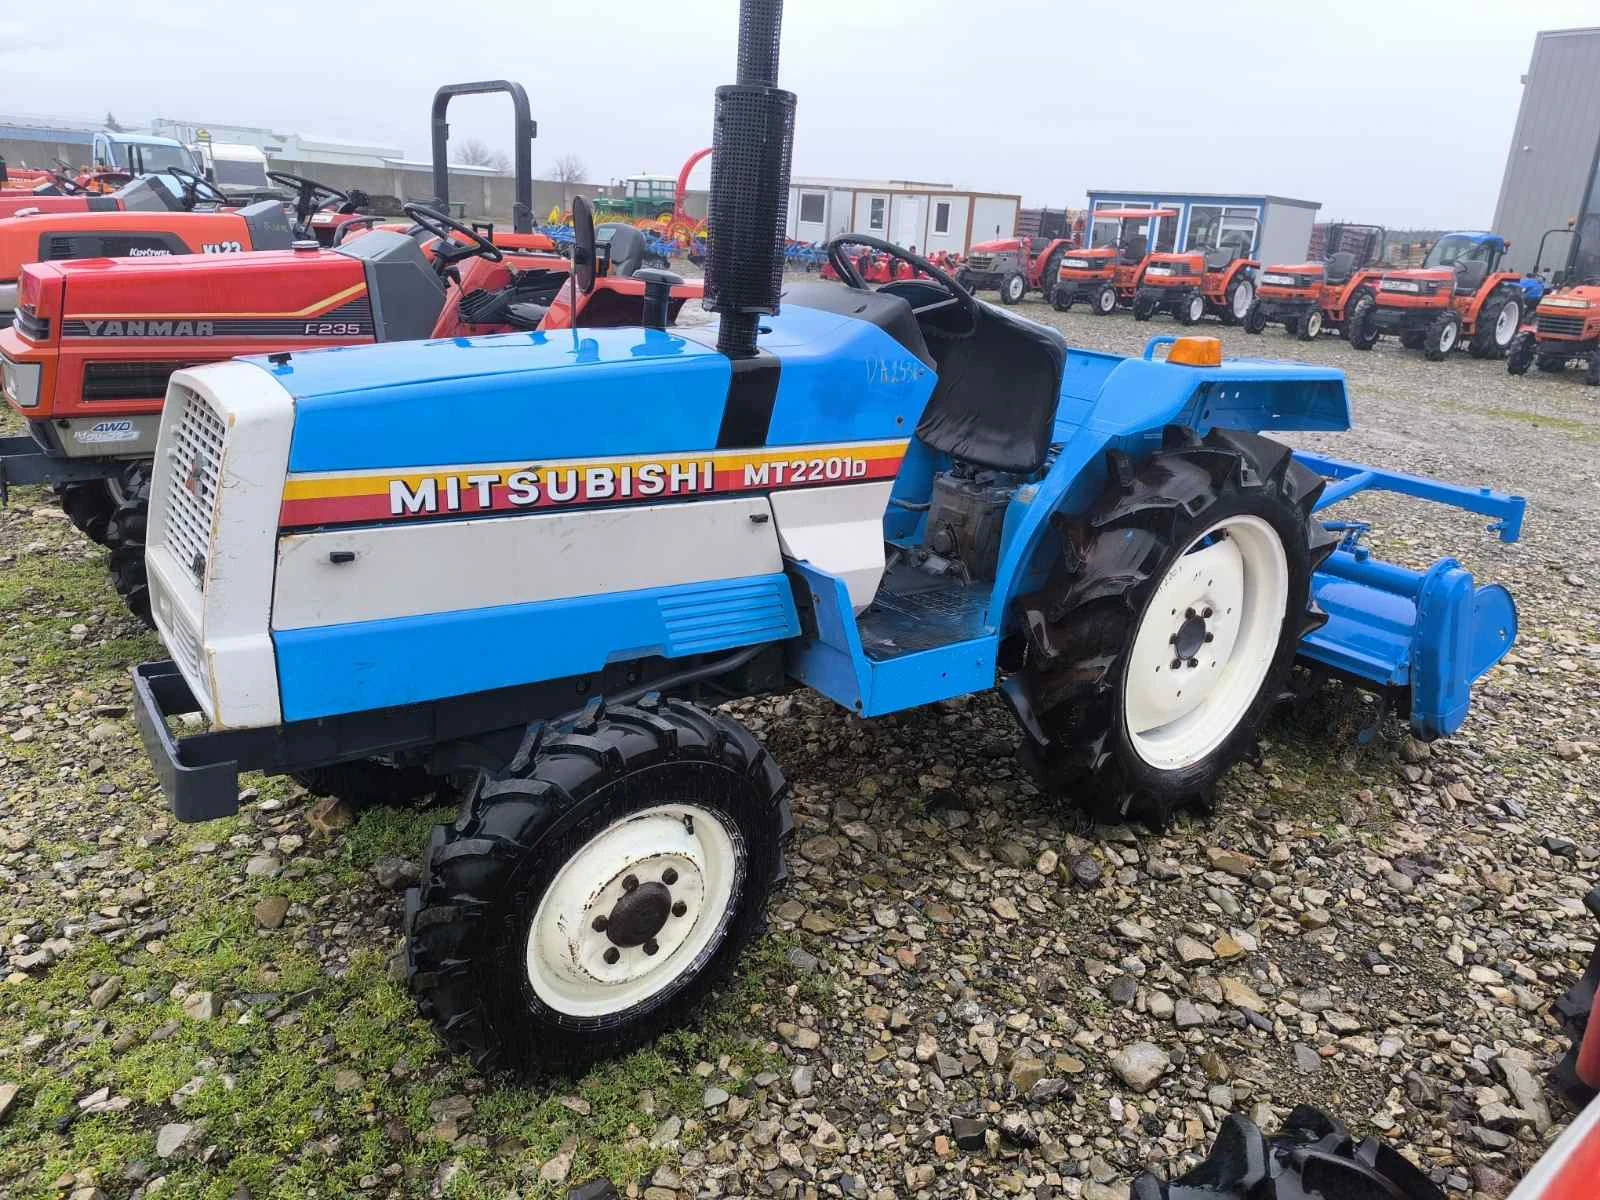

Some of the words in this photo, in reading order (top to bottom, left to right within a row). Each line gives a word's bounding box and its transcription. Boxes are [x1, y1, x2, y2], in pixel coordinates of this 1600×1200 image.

[82, 319, 214, 336] YANMAR
[304, 323, 361, 335] F235
[93, 421, 130, 432] 4WD
[389, 461, 714, 515] MITSUBISHI
[743, 456, 867, 487] MT2201D
